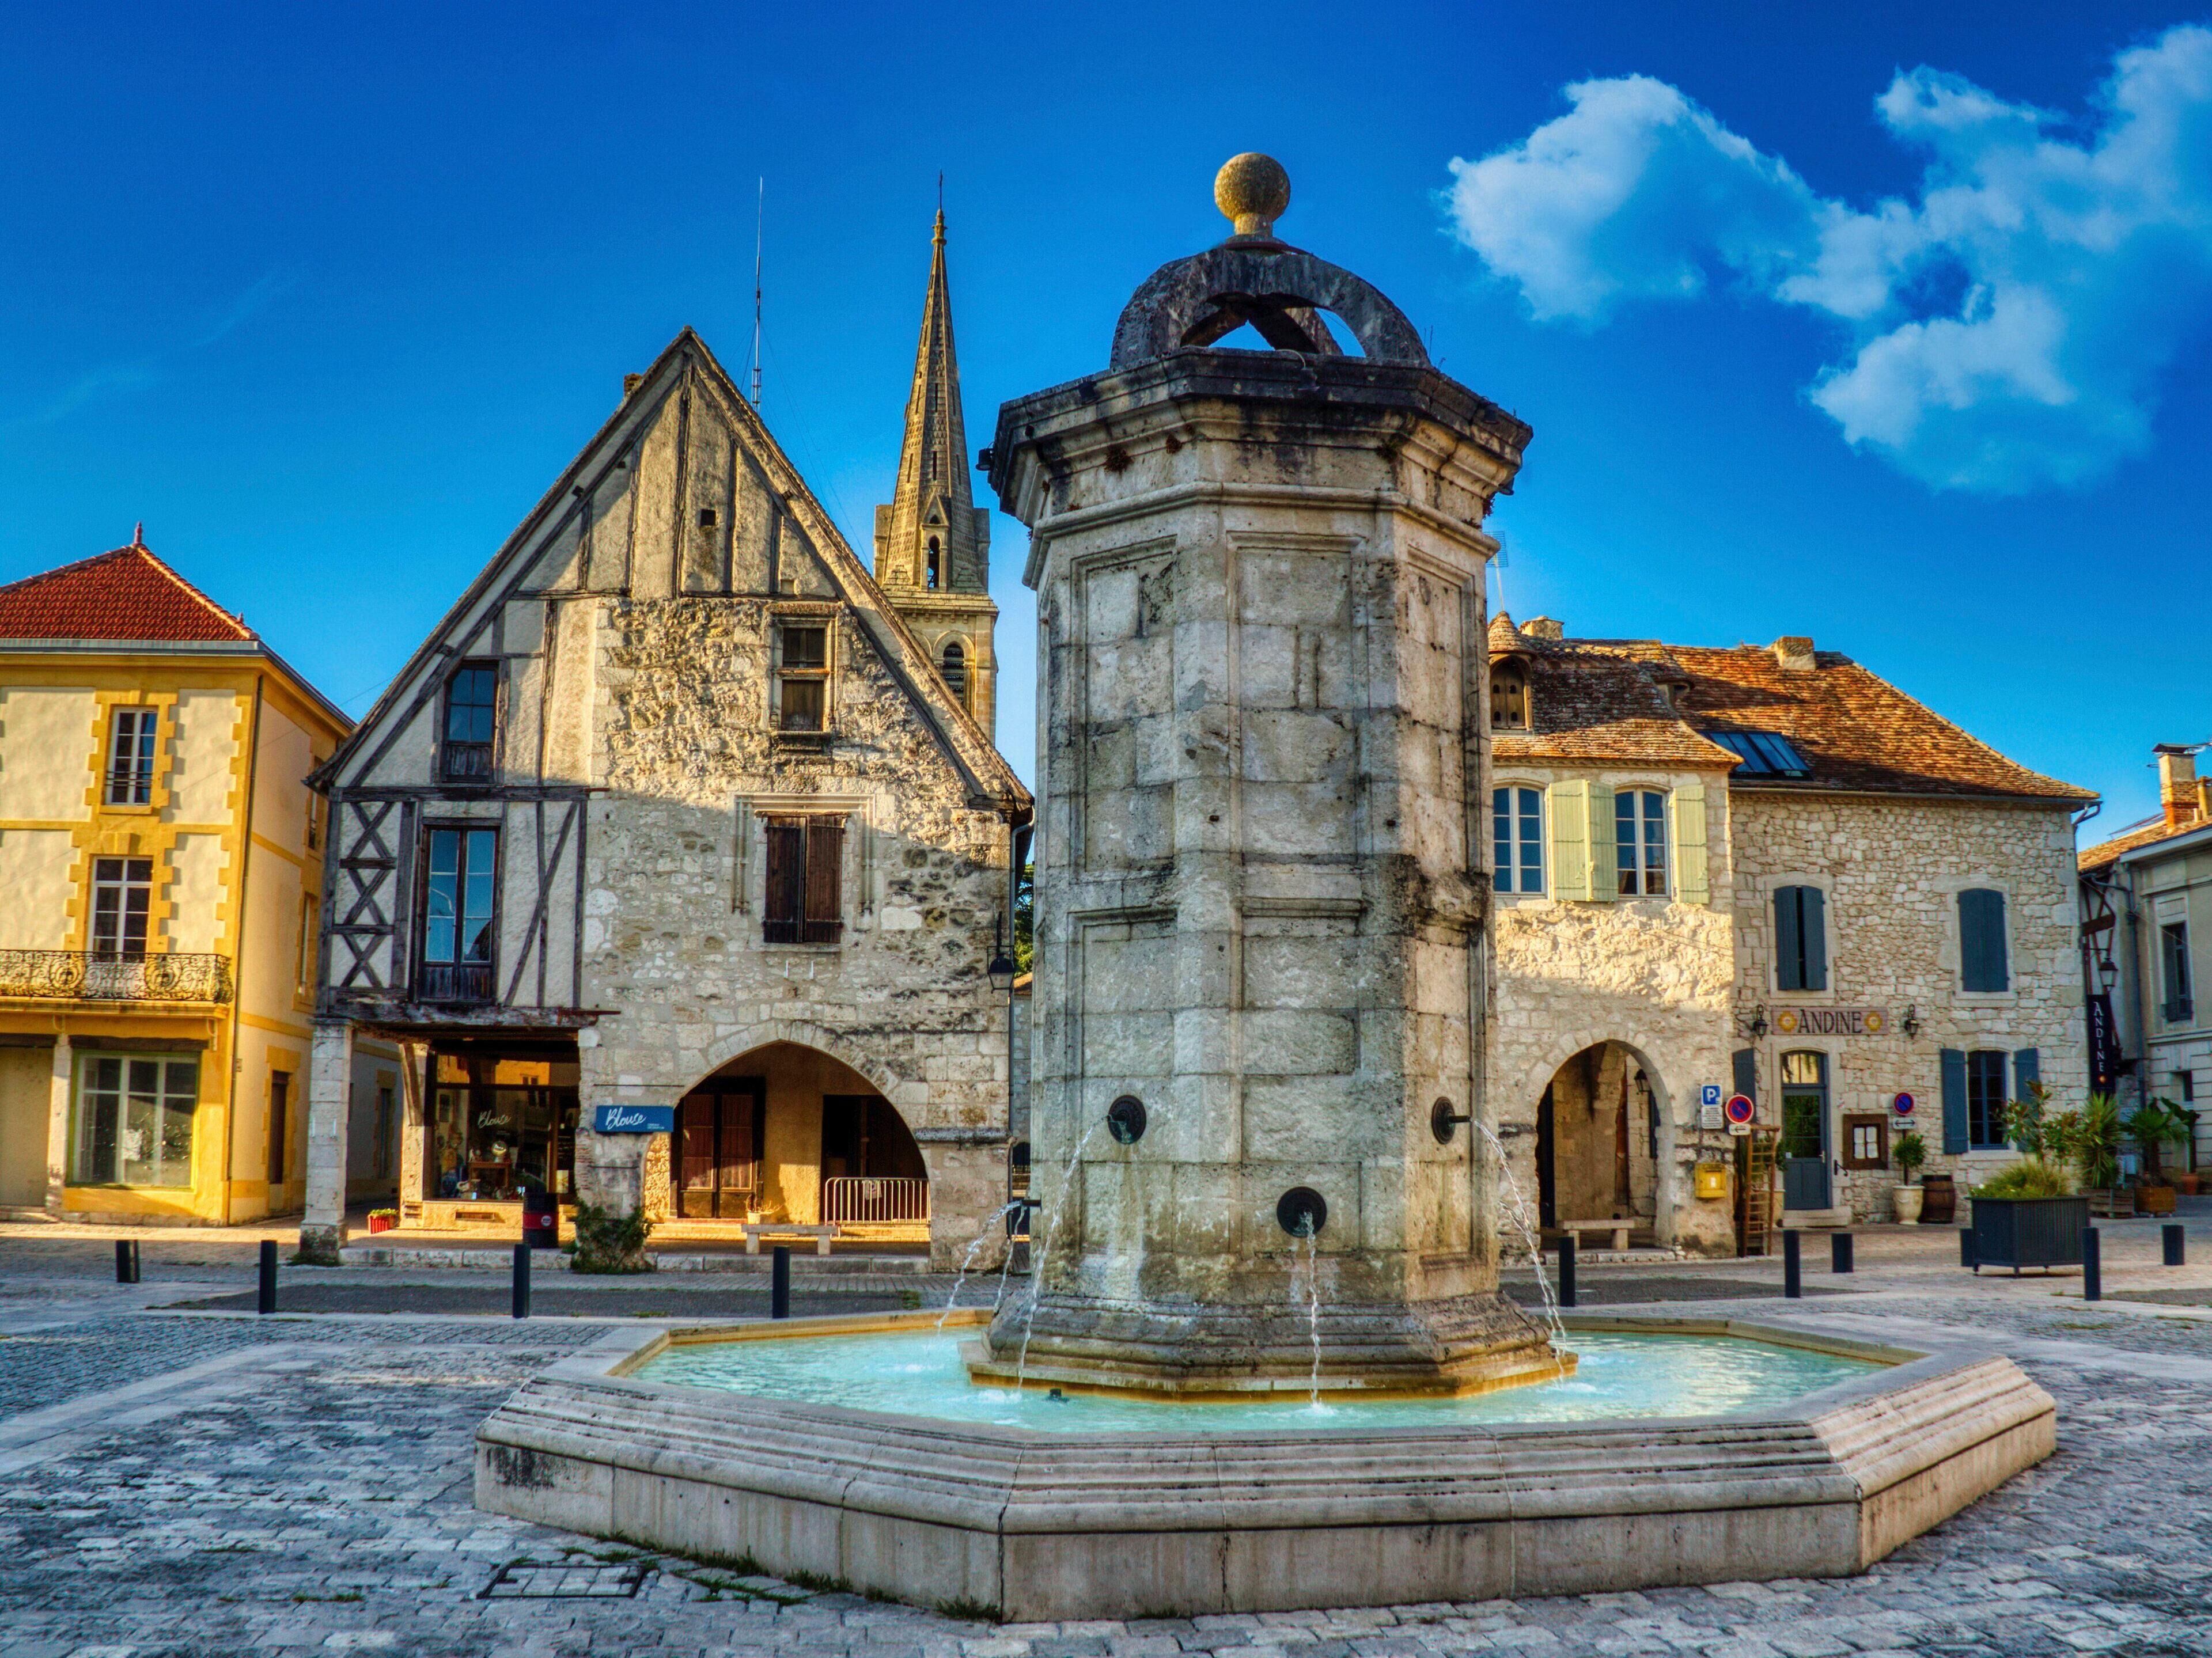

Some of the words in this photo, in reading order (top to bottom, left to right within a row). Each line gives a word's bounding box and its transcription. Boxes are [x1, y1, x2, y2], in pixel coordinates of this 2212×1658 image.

[1798, 1009, 1862, 1033] ANDINE
[2093, 1001, 2104, 1072] ANDINE
[1707, 1088, 1717, 1102] P
[478, 1109, 512, 1129] Blouse
[605, 1106, 647, 1130] Blouse
